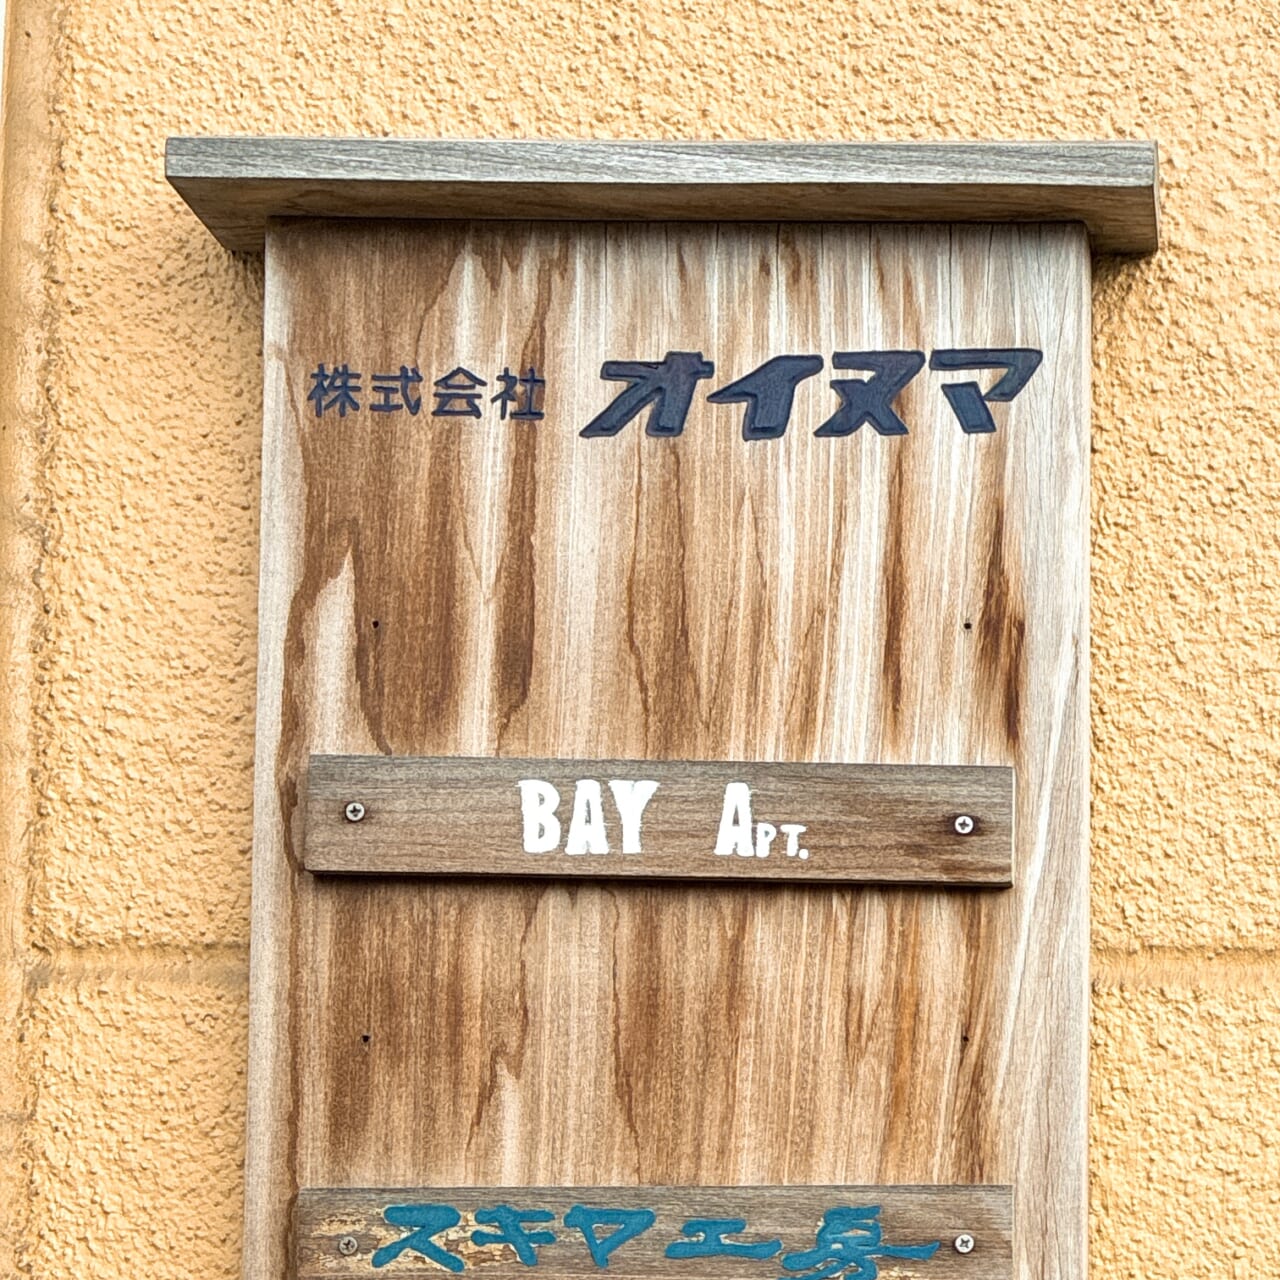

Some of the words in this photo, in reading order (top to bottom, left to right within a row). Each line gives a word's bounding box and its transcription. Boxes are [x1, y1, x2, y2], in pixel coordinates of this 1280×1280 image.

[306, 363, 547, 422] 株式会社
[579, 348, 1042, 440] オイヌマ
[515, 779, 660, 855] BAY
